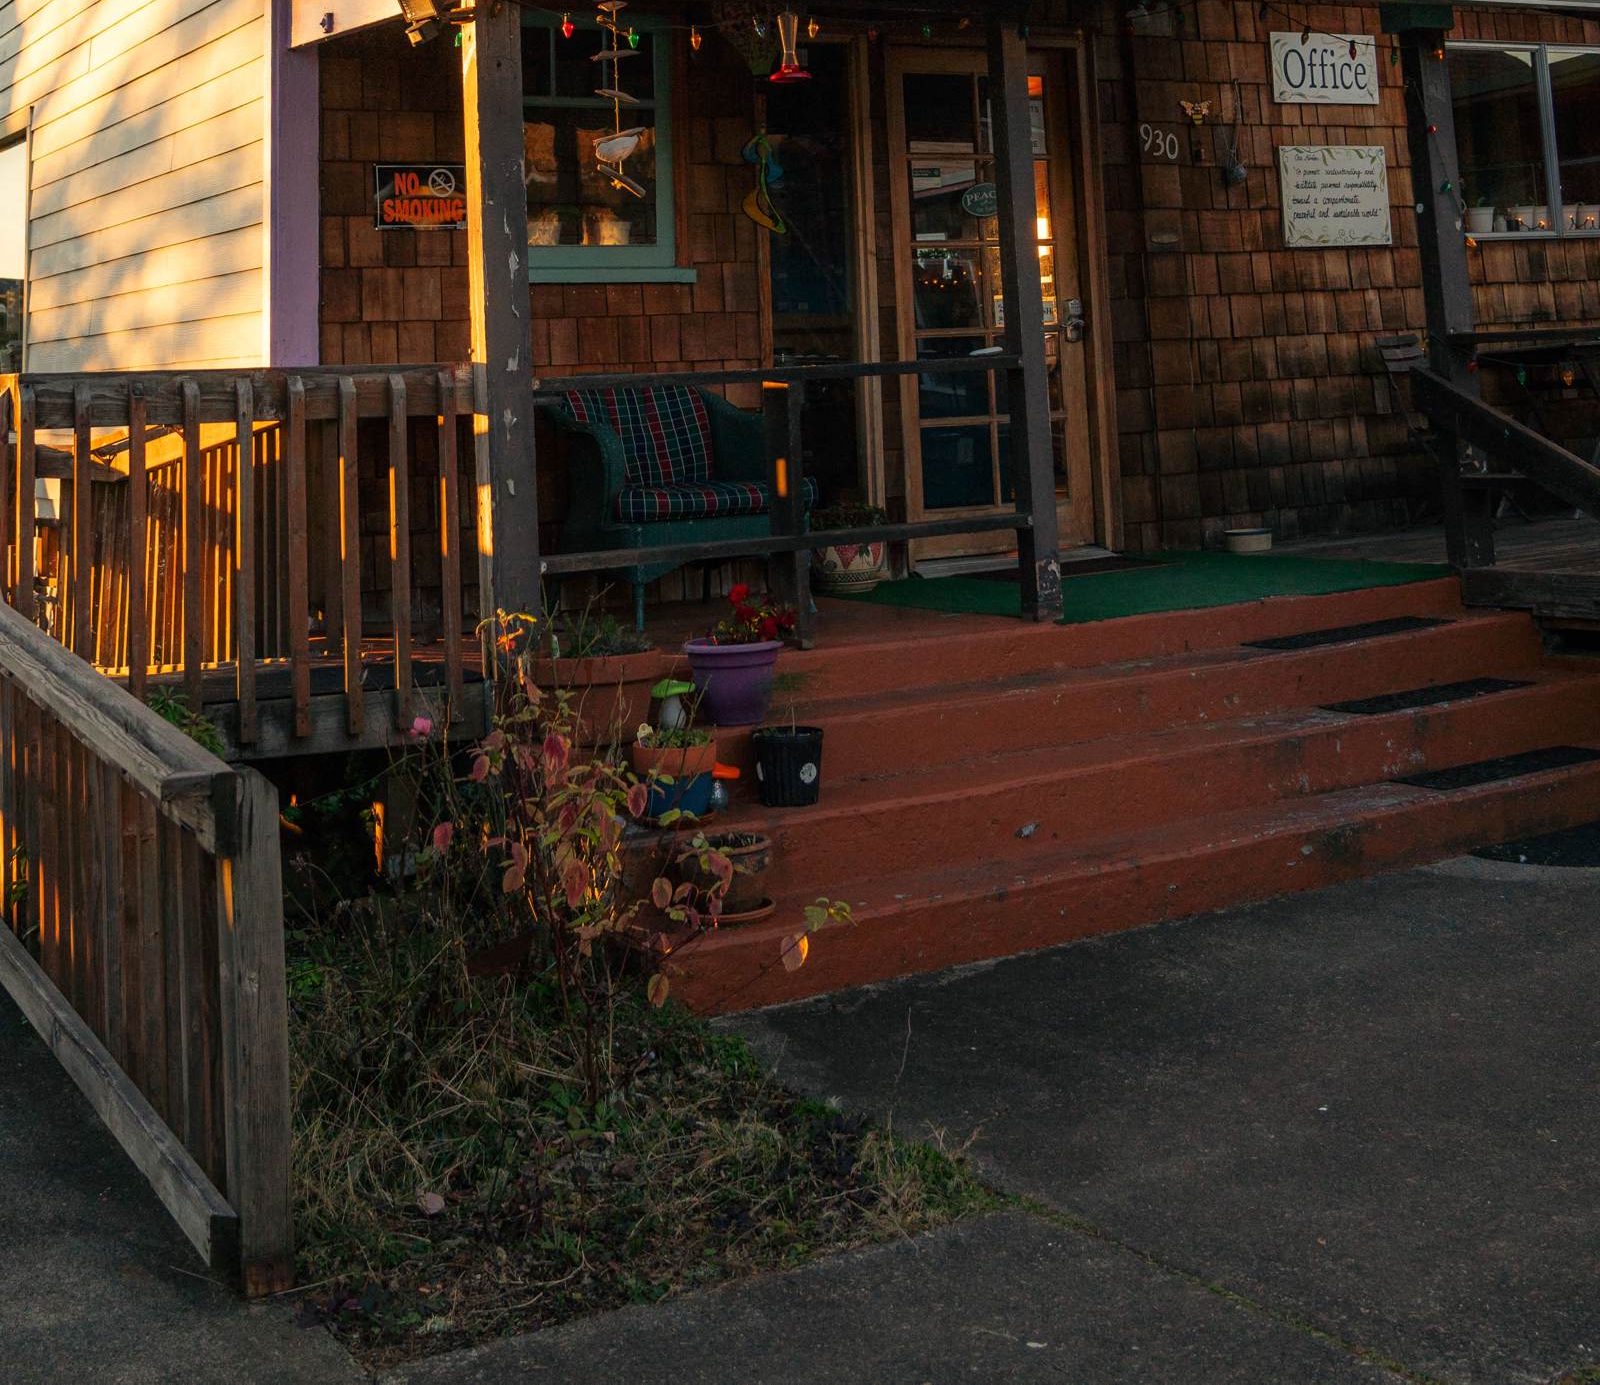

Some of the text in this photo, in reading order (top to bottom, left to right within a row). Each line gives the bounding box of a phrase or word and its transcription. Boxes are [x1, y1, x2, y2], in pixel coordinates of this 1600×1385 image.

[1283, 48, 1368, 90] Office
[1139, 123, 1179, 160] 930
[393, 172, 420, 196] NO
[383, 198, 464, 223] SMOKING
[965, 190, 997, 206] PEAC
